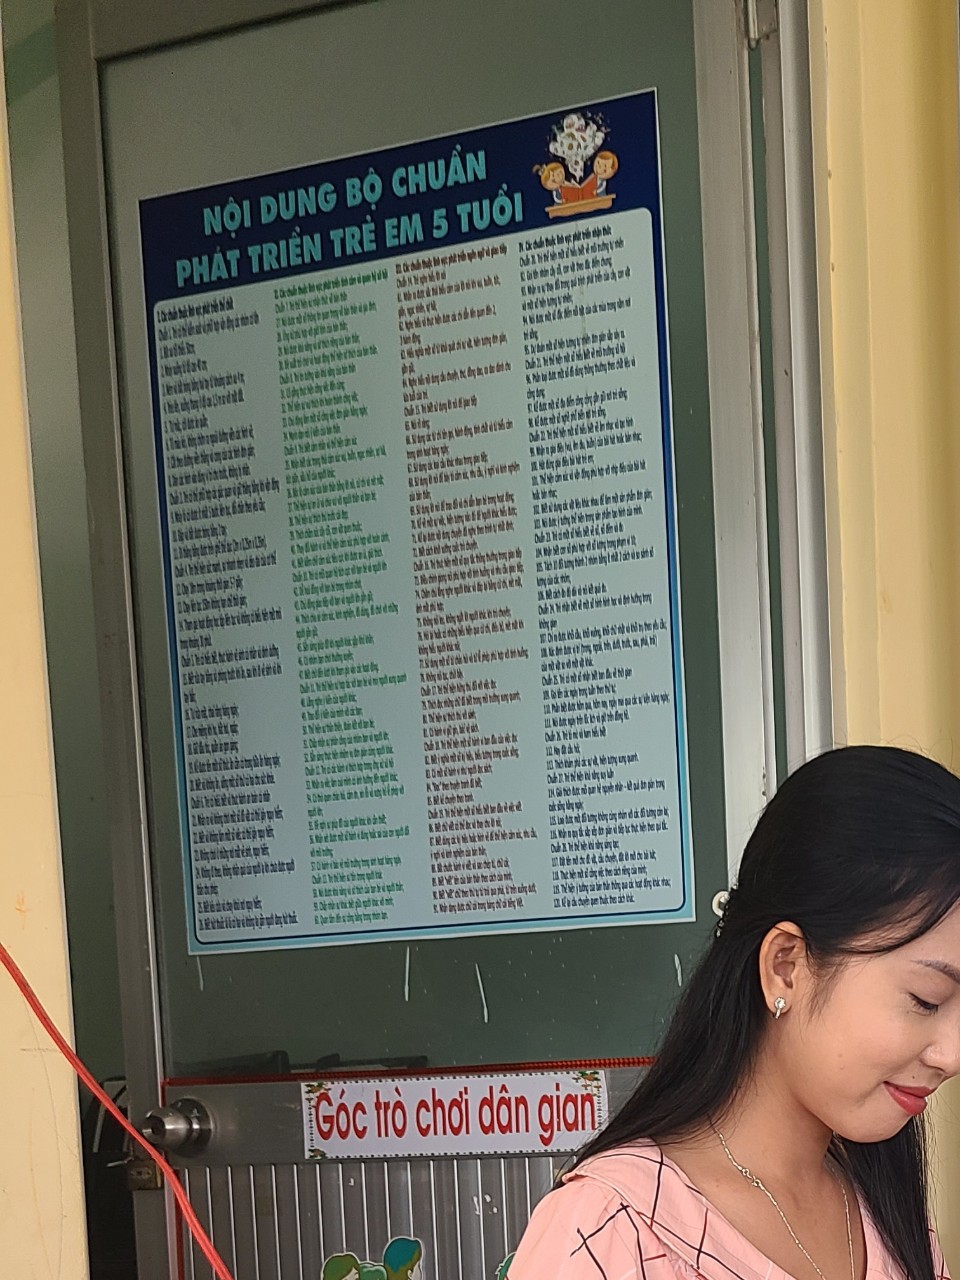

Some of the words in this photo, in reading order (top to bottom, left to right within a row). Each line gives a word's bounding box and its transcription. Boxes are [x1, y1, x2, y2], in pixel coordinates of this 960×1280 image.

[176, 246, 241, 288] PHÁT
[248, 226, 322, 273] TRIỂN
[330, 215, 377, 258] TRẺ
[385, 213, 424, 248] EM
[432, 208, 449, 239] 5
[456, 183, 523, 234] TUỔI
[203, 196, 251, 239] NỘI
[260, 182, 337, 225] DUNG
[346, 167, 383, 211] BỘ
[392, 143, 487, 198] CHUẨN
[315, 1087, 368, 1141] Góc
[374, 1086, 407, 1138] trò
[416, 1086, 470, 1137] chơi
[478, 1084, 530, 1135] dân
[537, 1082, 596, 1146] gian
